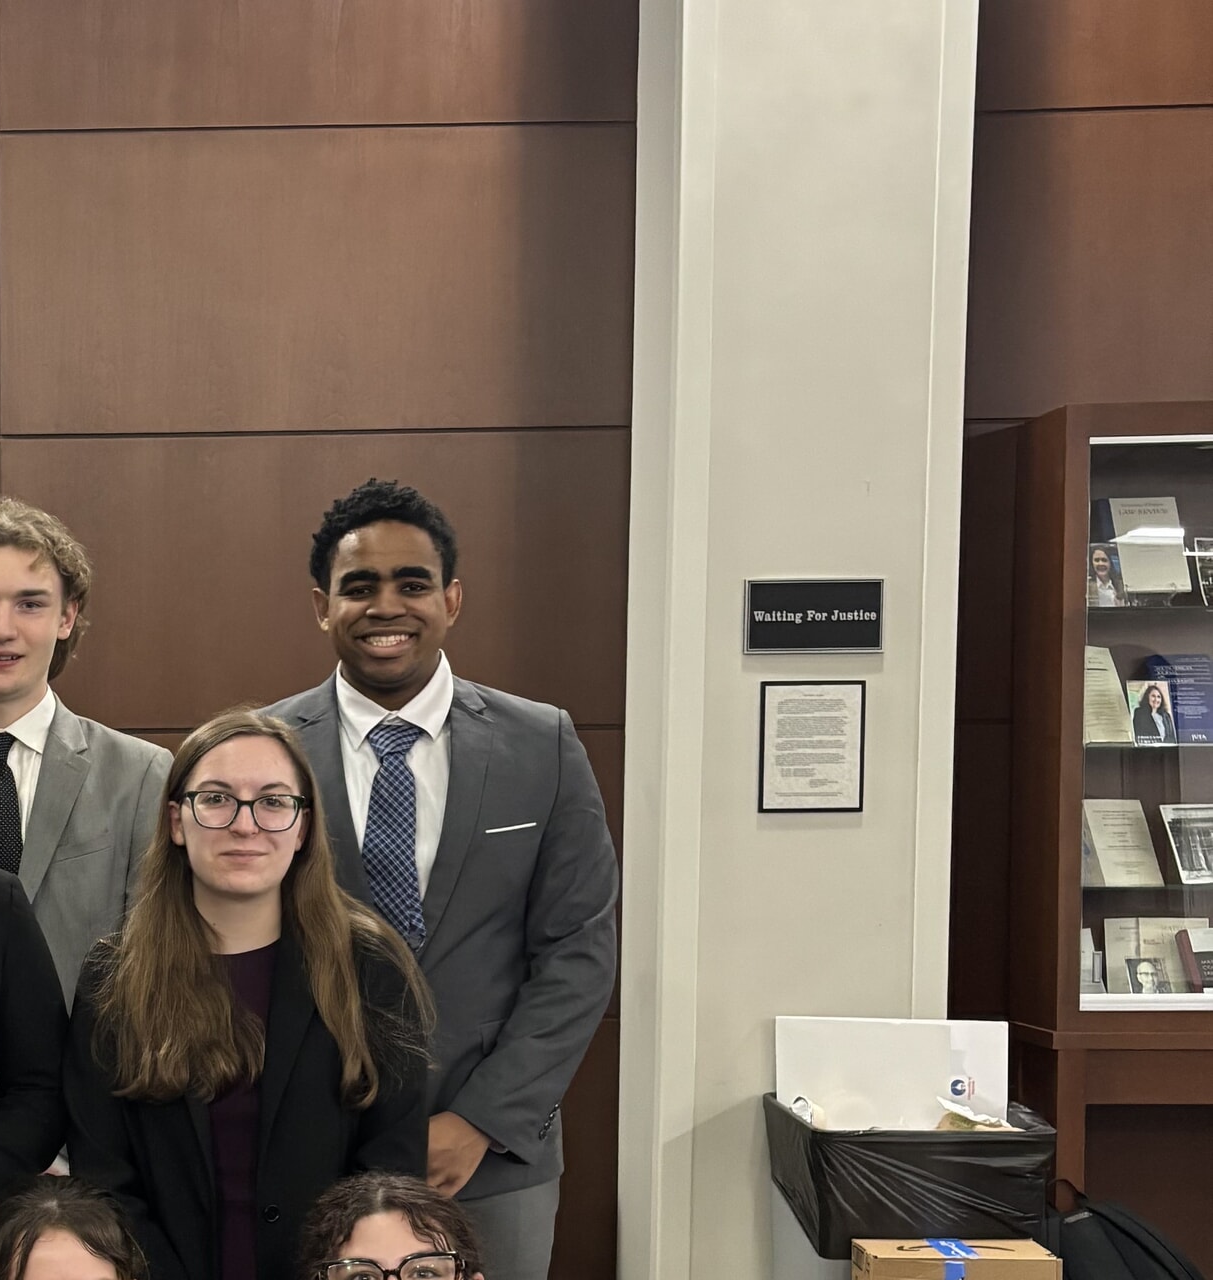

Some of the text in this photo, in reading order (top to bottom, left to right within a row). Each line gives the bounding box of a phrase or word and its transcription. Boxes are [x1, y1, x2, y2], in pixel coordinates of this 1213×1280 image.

[753, 609, 877, 624] Waiting For Justice
